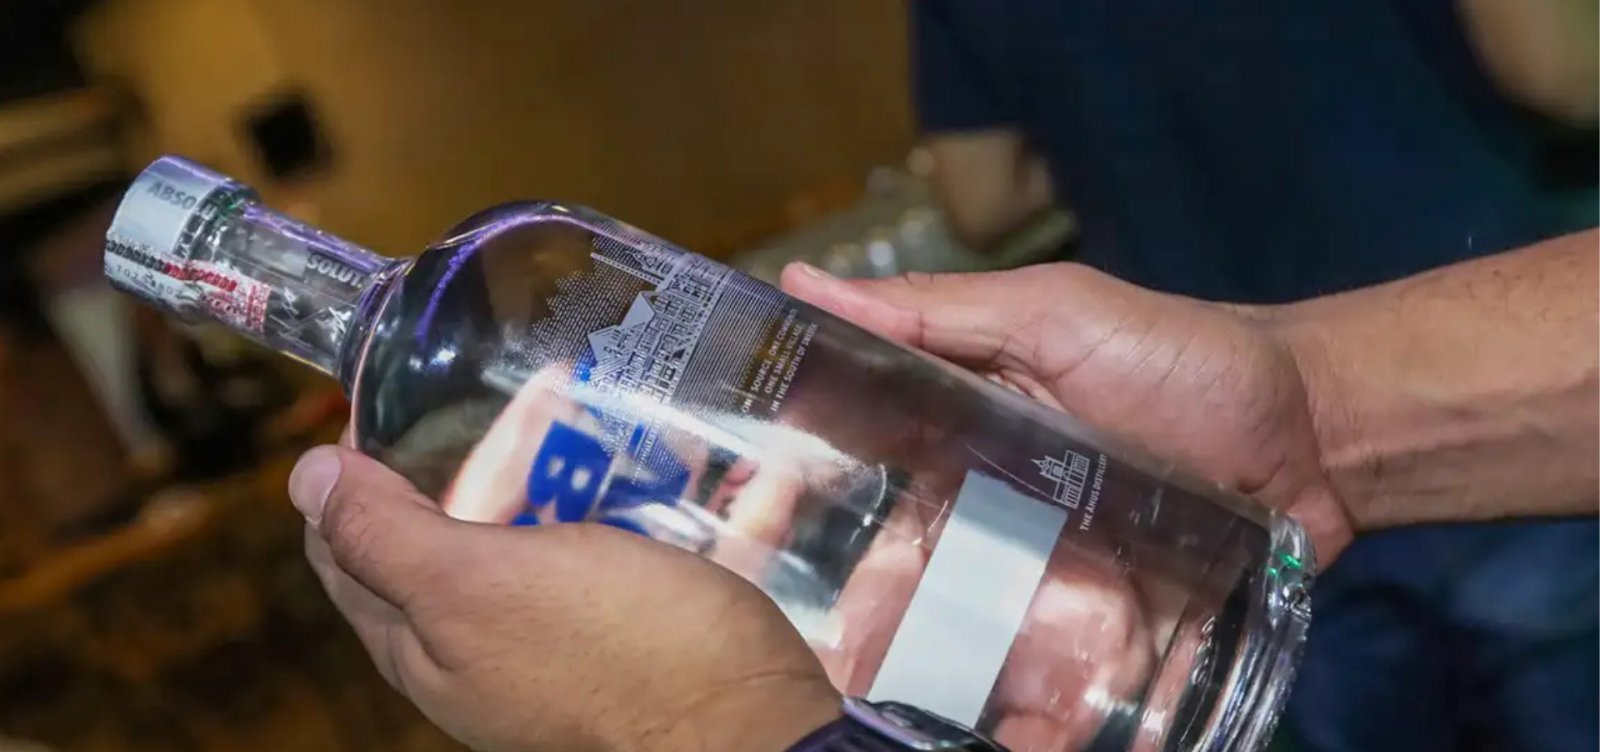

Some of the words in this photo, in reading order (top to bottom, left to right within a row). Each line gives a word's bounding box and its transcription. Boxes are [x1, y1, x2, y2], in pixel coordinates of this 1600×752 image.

[764, 375, 778, 394] ONE
[774, 350, 792, 375] SMALL
[770, 400, 781, 412] IN
[776, 380, 790, 400] THE
[784, 354, 802, 382] SOUTH
[797, 343, 807, 356] OF
[1080, 513, 1094, 531] THE
